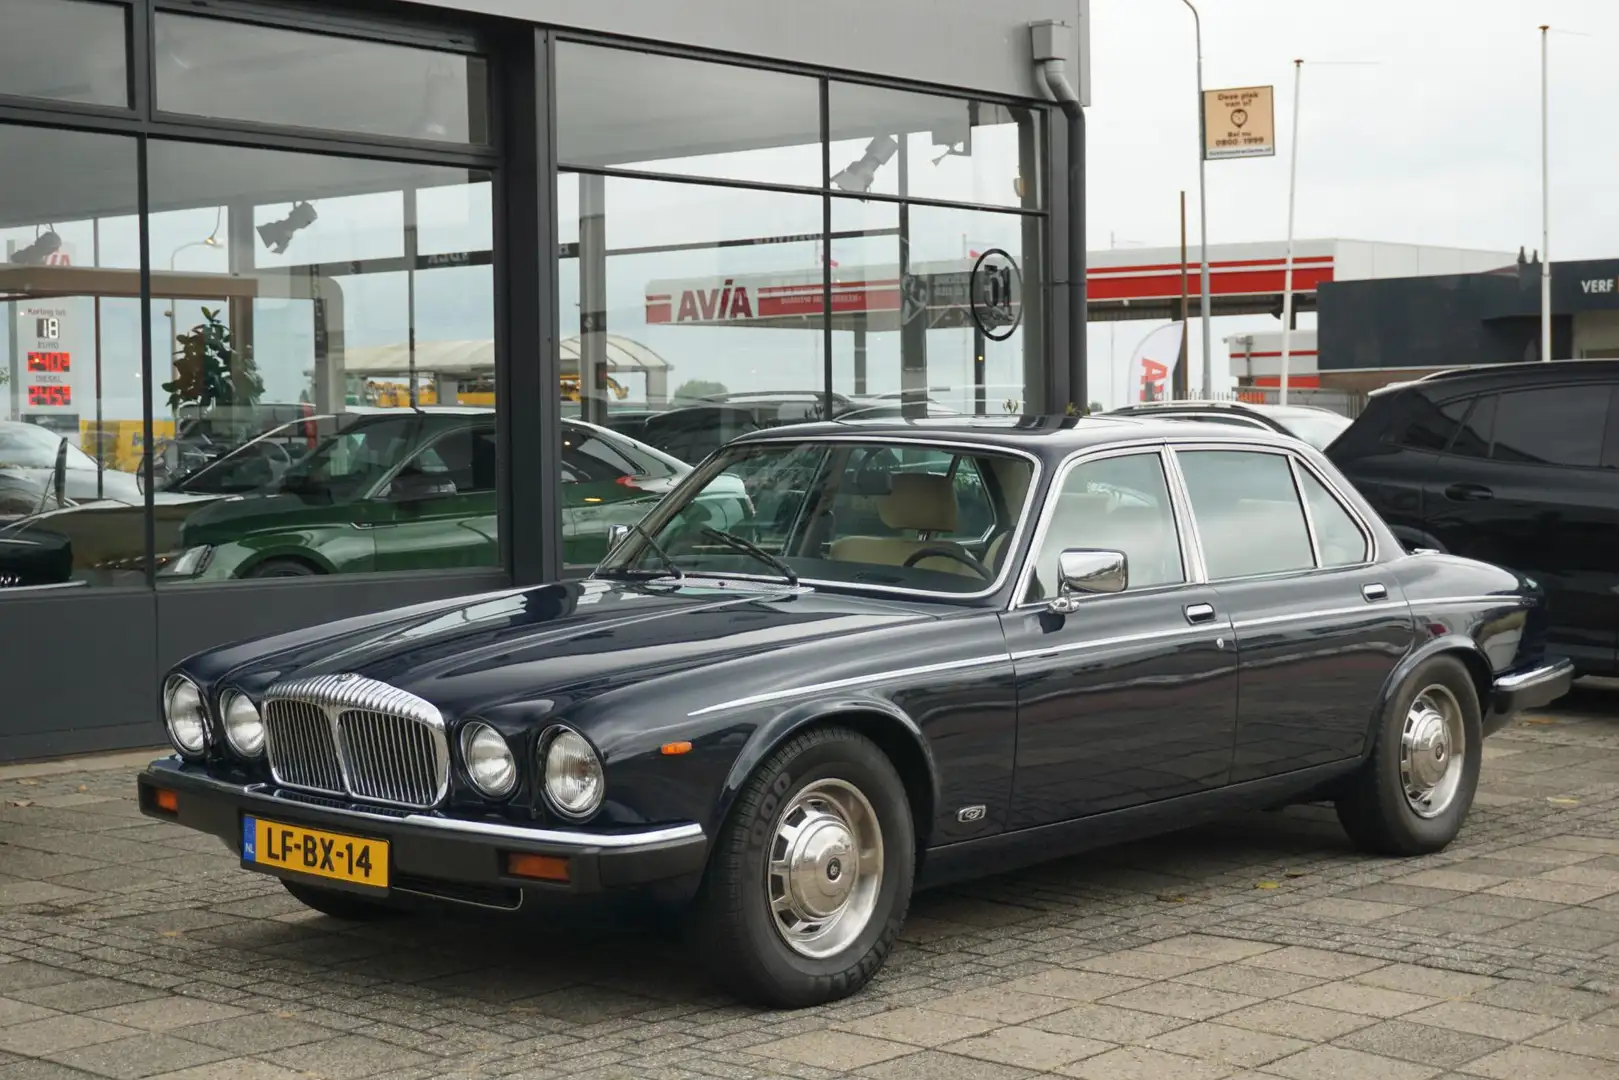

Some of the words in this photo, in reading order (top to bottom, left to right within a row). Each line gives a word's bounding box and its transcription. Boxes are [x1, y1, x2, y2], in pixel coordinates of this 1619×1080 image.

[1581, 279, 1614, 294] VERF
[245, 842, 255, 854] NL
[267, 827, 373, 878] LF-BX-14
